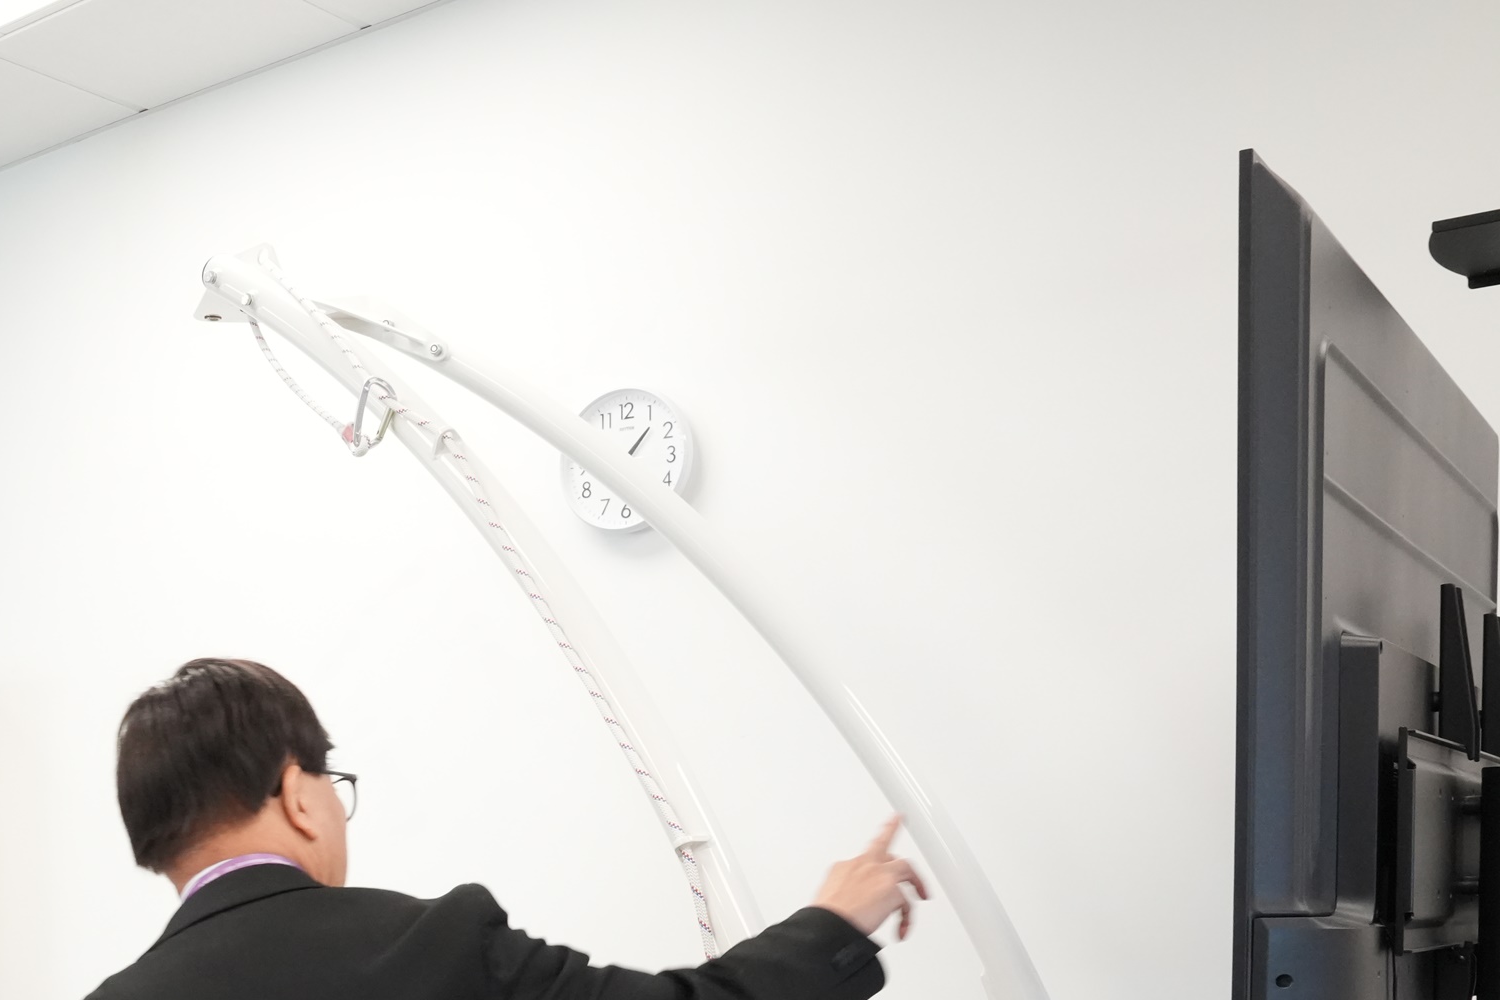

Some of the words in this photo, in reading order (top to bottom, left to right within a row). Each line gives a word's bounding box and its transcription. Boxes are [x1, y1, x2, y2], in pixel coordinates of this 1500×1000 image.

[619, 402, 634, 420] 12
[647, 404, 652, 421] 1
[600, 412, 612, 430] 11
[662, 421, 673, 439] 2
[666, 445, 676, 463] 3
[662, 470, 672, 487] 4
[581, 481, 592, 499] 8
[600, 498, 610, 516] 7
[620, 504, 632, 518] 6
